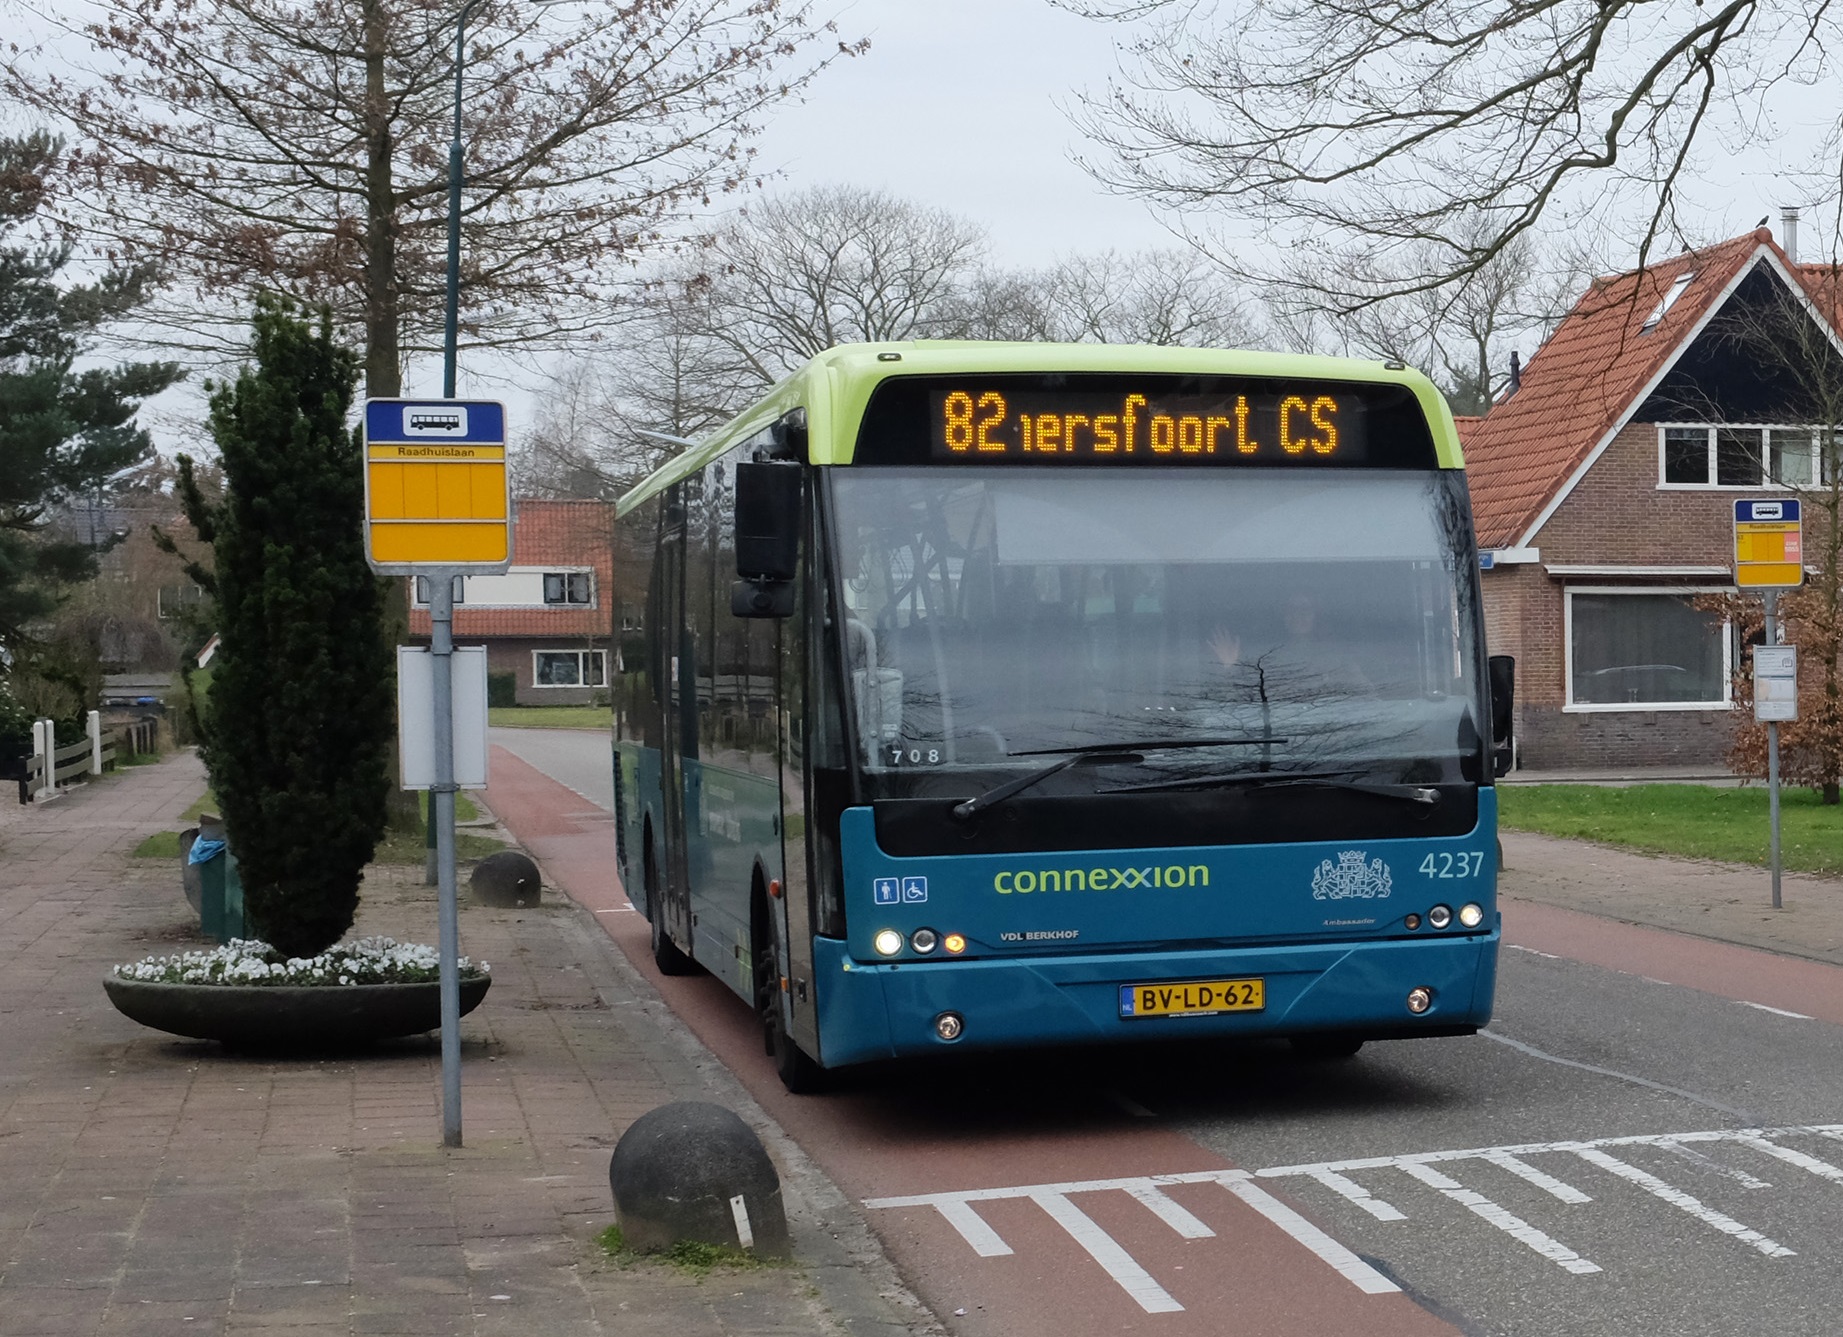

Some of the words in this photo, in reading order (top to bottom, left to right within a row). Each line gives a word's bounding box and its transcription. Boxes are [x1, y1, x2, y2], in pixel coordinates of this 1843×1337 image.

[944, 391, 1006, 452] 82
[1279, 396, 1338, 454] CS
[397, 446, 475, 457] Raadhuislaan
[1418, 851, 1485, 879] 4237
[993, 864, 1210, 895] connexxion
[1000, 932, 1024, 942] VDL
[1025, 929, 1080, 941] BERKHOF
[1142, 984, 1255, 1011] BV-LD-62
